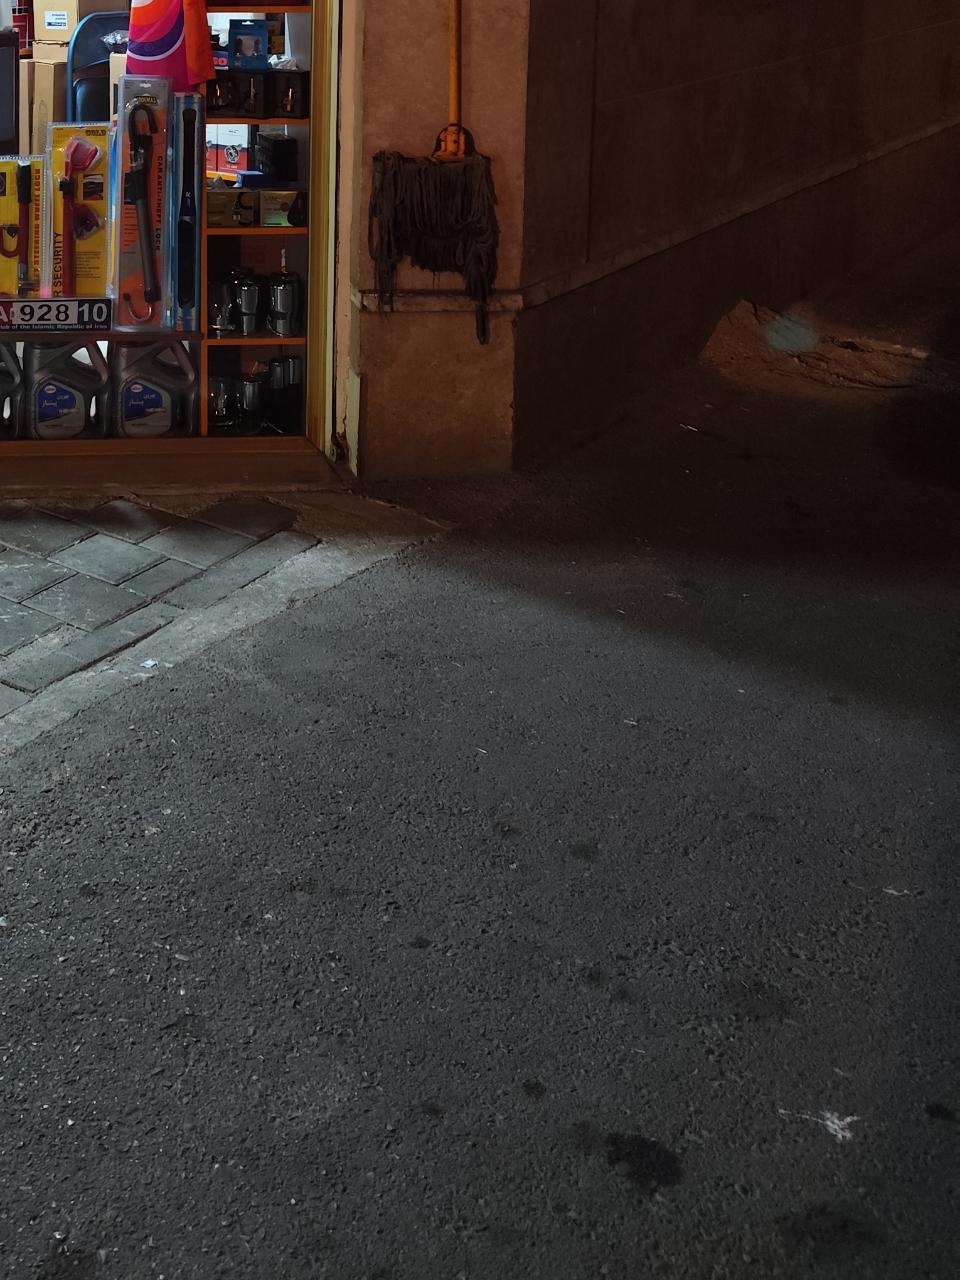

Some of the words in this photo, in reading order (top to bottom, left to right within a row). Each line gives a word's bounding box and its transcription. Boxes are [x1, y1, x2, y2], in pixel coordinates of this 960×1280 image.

[53, 231, 62, 288] SECURITY
[19, 303, 70, 323] 928
[78, 303, 108, 322] 10
